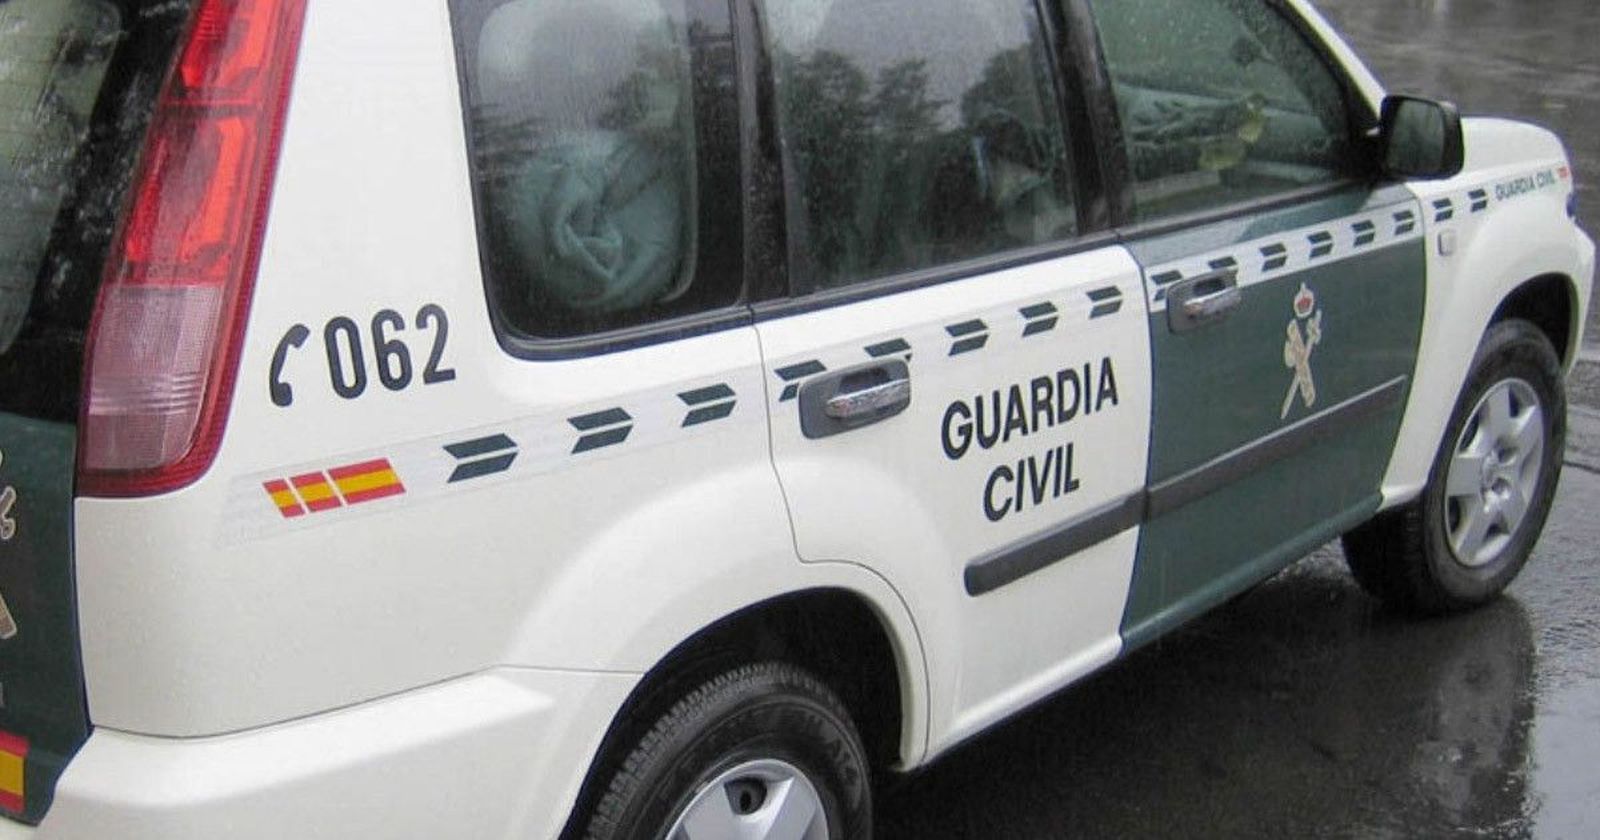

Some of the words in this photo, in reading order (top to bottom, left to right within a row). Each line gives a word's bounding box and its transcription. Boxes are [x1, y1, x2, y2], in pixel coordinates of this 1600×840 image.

[1495, 175, 1535, 200] GUARDIA
[1536, 169, 1555, 187] CIVIL
[324, 303, 456, 399] 062
[941, 357, 1119, 460] GUARDIA
[983, 443, 1080, 522] CIVIL
